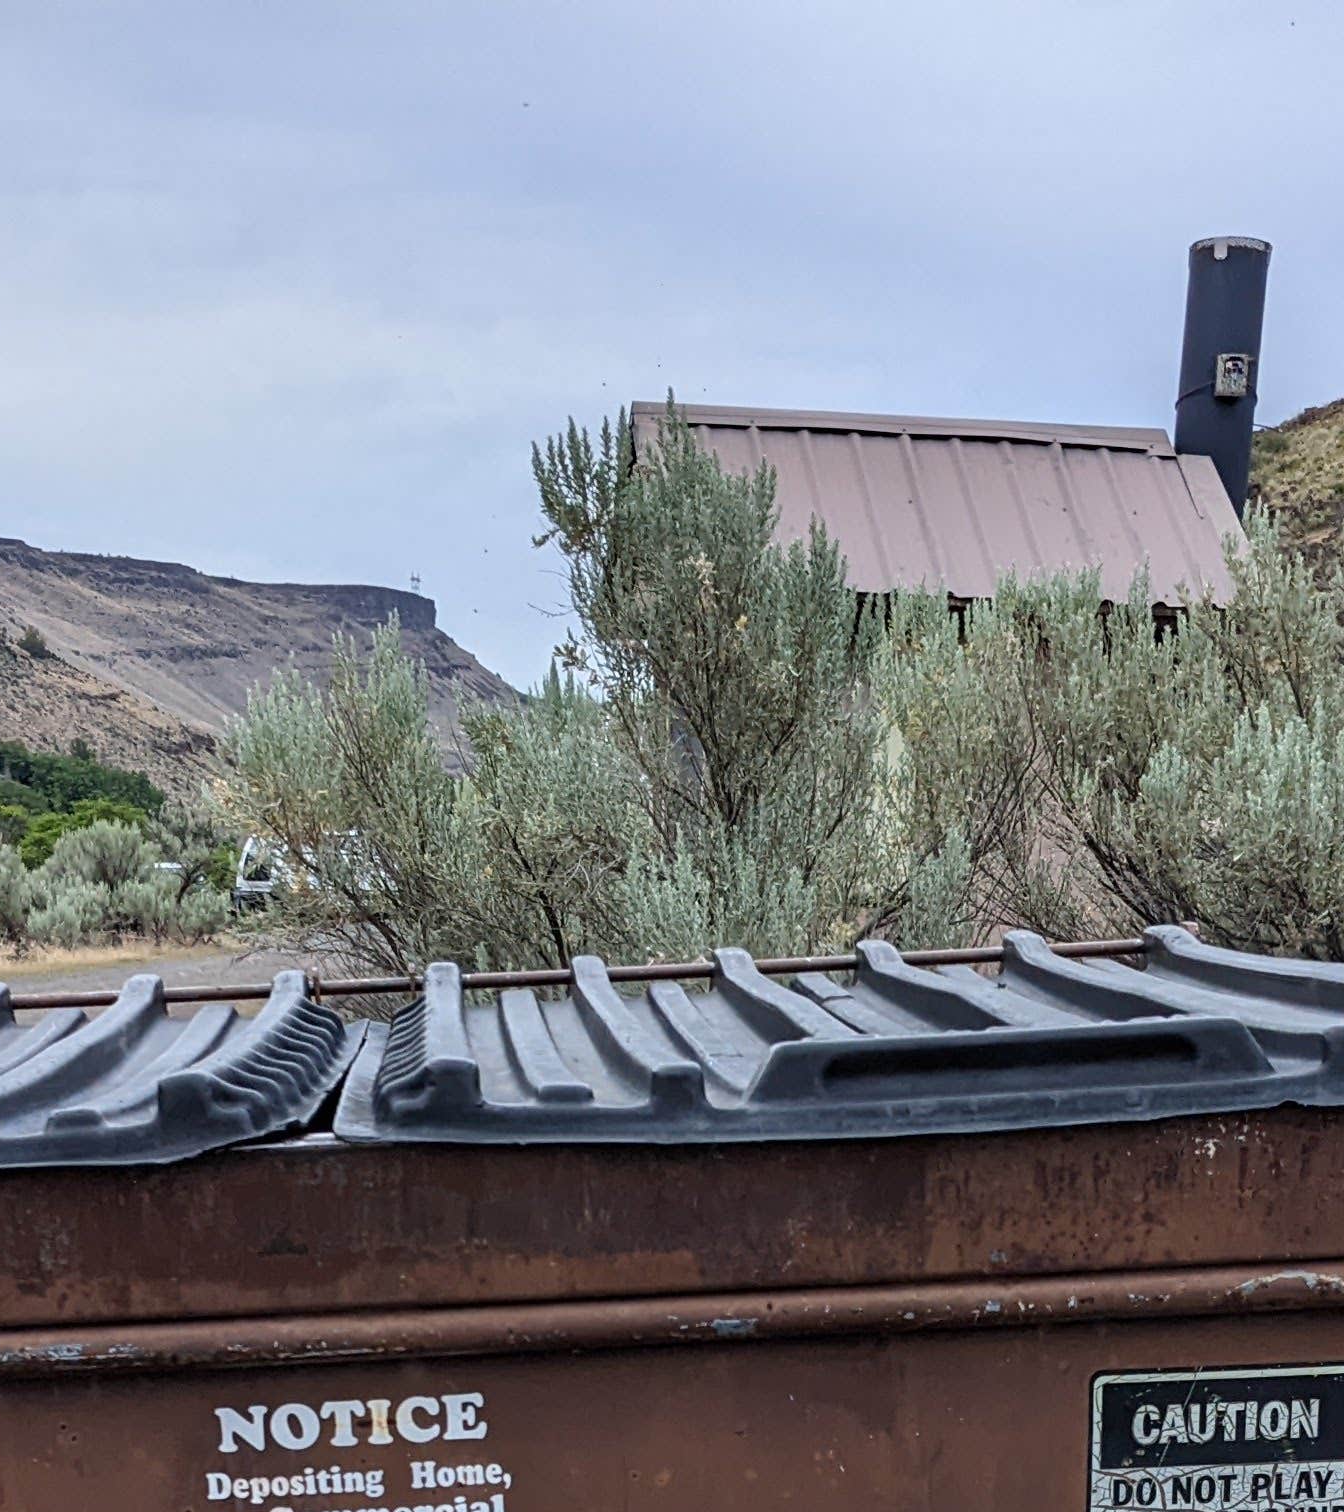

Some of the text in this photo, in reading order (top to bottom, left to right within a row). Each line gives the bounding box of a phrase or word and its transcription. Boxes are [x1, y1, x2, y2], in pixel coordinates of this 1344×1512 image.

[214, 1392, 488, 1453] NOTICE
[1131, 1398, 1321, 1446] CAUTION
[205, 1459, 513, 1504] Depositing Home,
[1112, 1470, 1334, 1506] DO NOT PLAY
